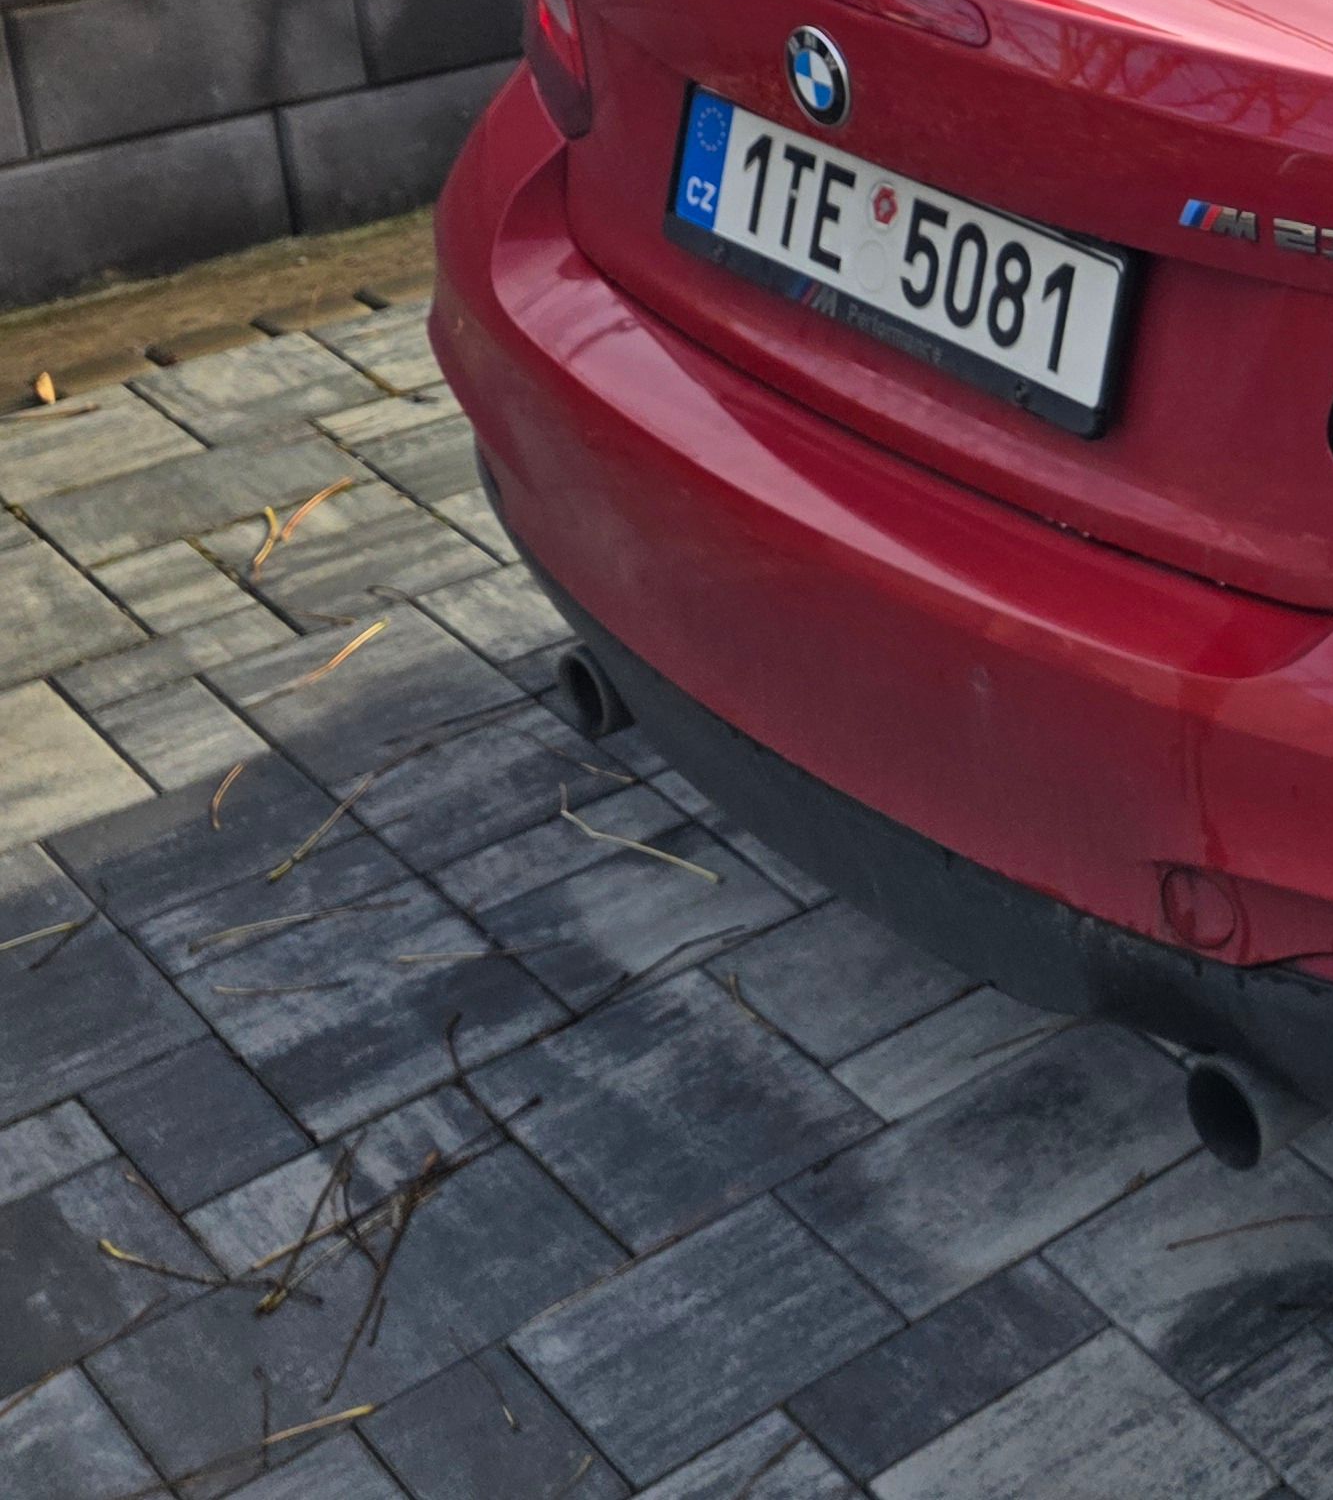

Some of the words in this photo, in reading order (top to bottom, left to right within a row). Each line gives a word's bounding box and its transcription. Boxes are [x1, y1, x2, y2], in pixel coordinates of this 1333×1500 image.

[686, 175, 718, 213] CZ
[743, 133, 856, 274] 1TE
[900, 197, 1076, 375] 5081
